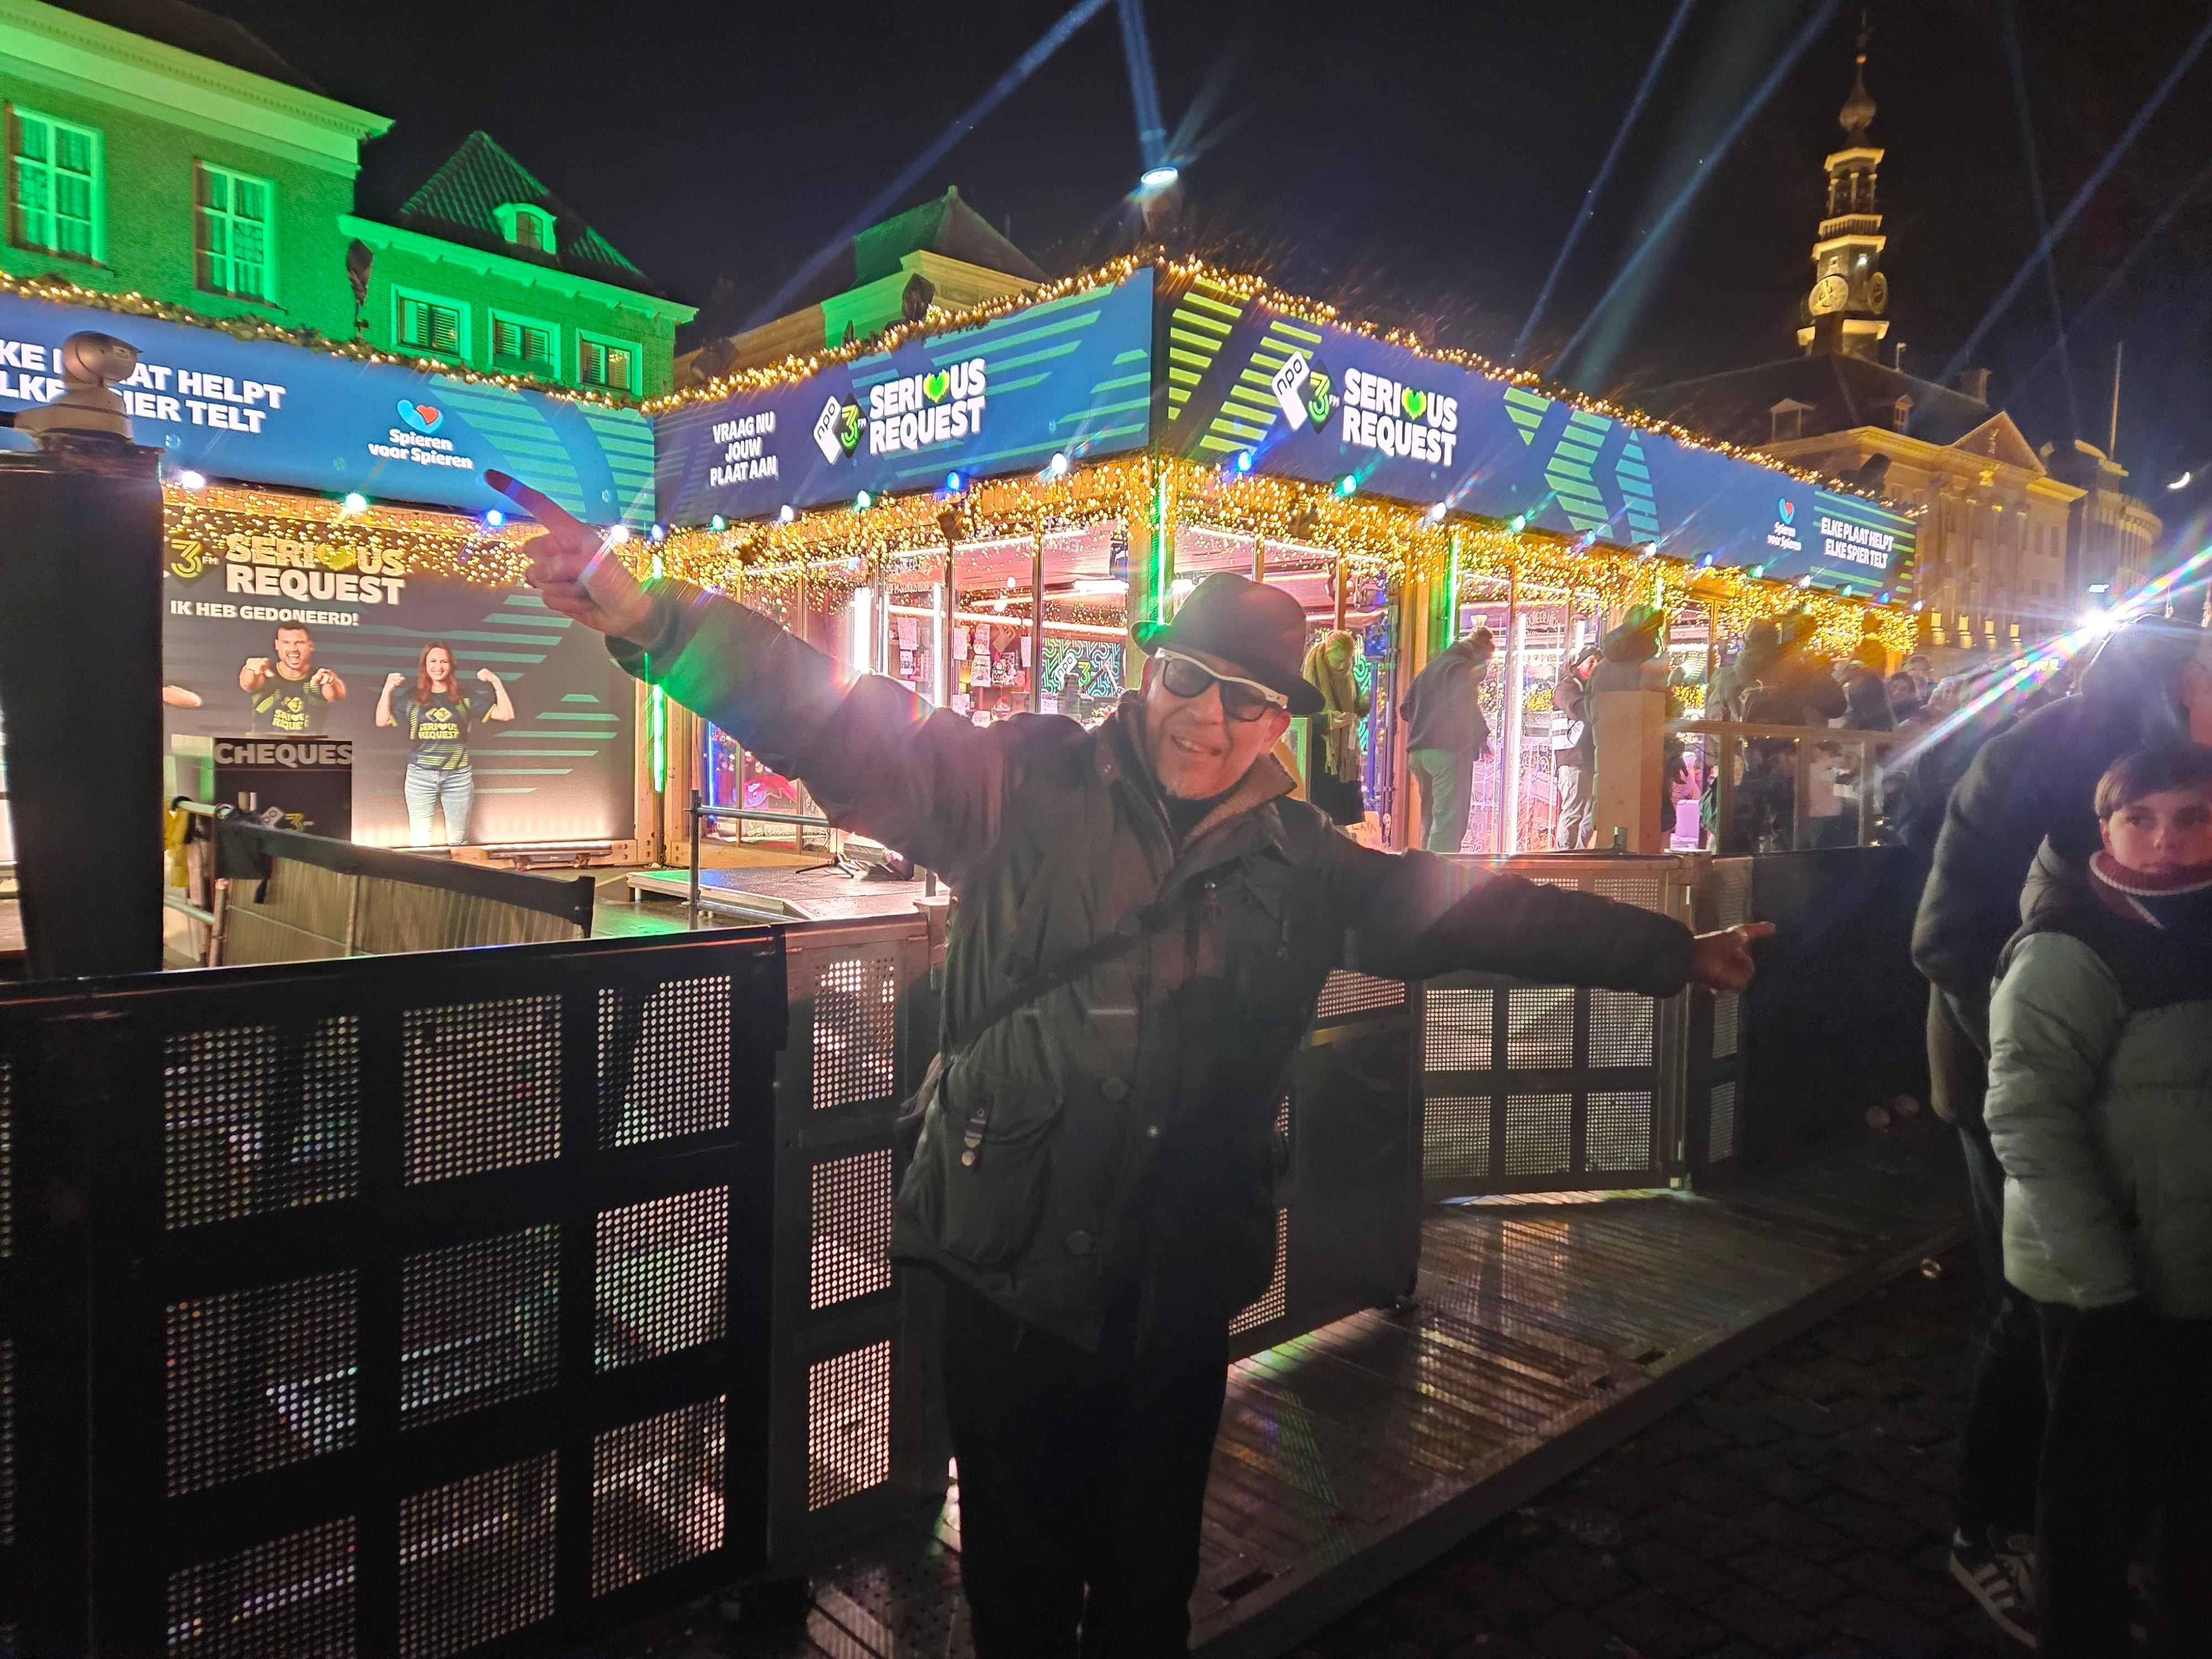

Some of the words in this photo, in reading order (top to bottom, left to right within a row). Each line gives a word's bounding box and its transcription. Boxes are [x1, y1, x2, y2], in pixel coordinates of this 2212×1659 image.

[178, 369, 286, 409] HELPT
[108, 388, 181, 422] IER
[185, 400, 266, 434] TELT
[870, 396, 985, 455] REQUEST
[389, 428, 453, 451] Spieren
[713, 416, 755, 444] VRAAG
[756, 411, 775, 434] NU
[1342, 406, 1457, 467] REQUEST
[368, 443, 409, 460] voor
[410, 447, 474, 469] Spieren
[725, 436, 762, 462] JOUW
[710, 461, 748, 486] PLAAT
[749, 455, 777, 479] AAN
[1821, 517, 1844, 539] ELKE
[1843, 523, 1870, 545] PLAAT
[1869, 530, 1894, 552] HELPT
[1824, 538, 1847, 559] ELKE
[1846, 544, 1870, 564] SPIER
[1869, 550, 1888, 569] TELT
[226, 564, 406, 605] REQUEST
[170, 600, 193, 615] IK
[196, 602, 238, 619] HEB
[239, 605, 359, 626] GEDONEERD!
[213, 743, 352, 768] CHEQUES
